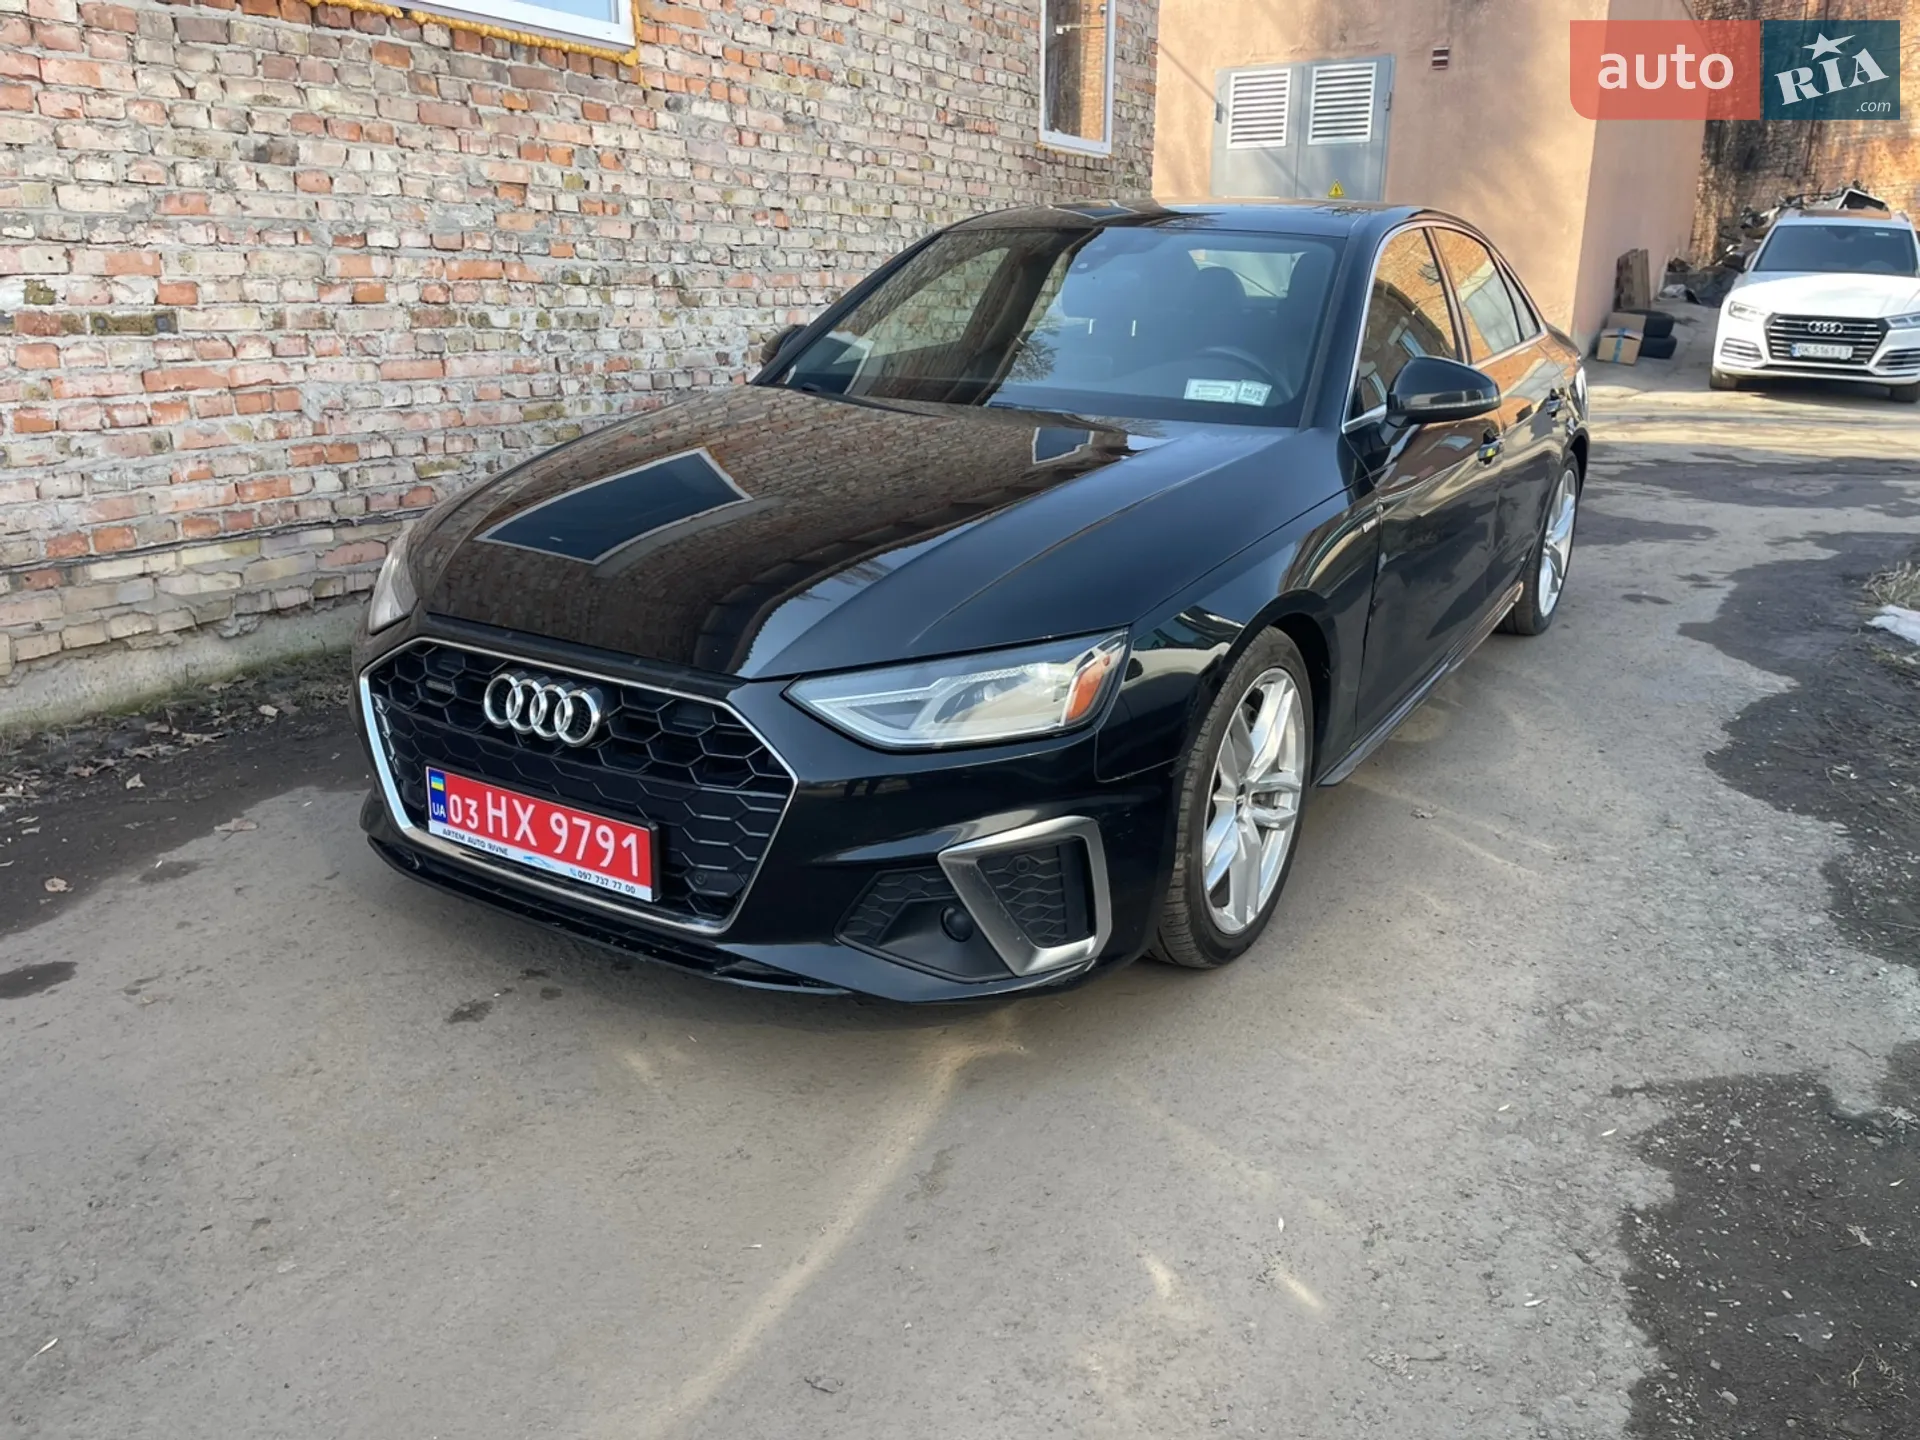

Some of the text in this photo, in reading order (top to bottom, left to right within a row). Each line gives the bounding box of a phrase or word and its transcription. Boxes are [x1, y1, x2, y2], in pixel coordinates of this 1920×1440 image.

[432, 801, 447, 818] UA
[442, 828, 466, 841] ARTEM
[467, 836, 486, 848] AUTO
[449, 791, 639, 878] 03 HX 9791
[577, 870, 636, 894] 097 737 77 00
